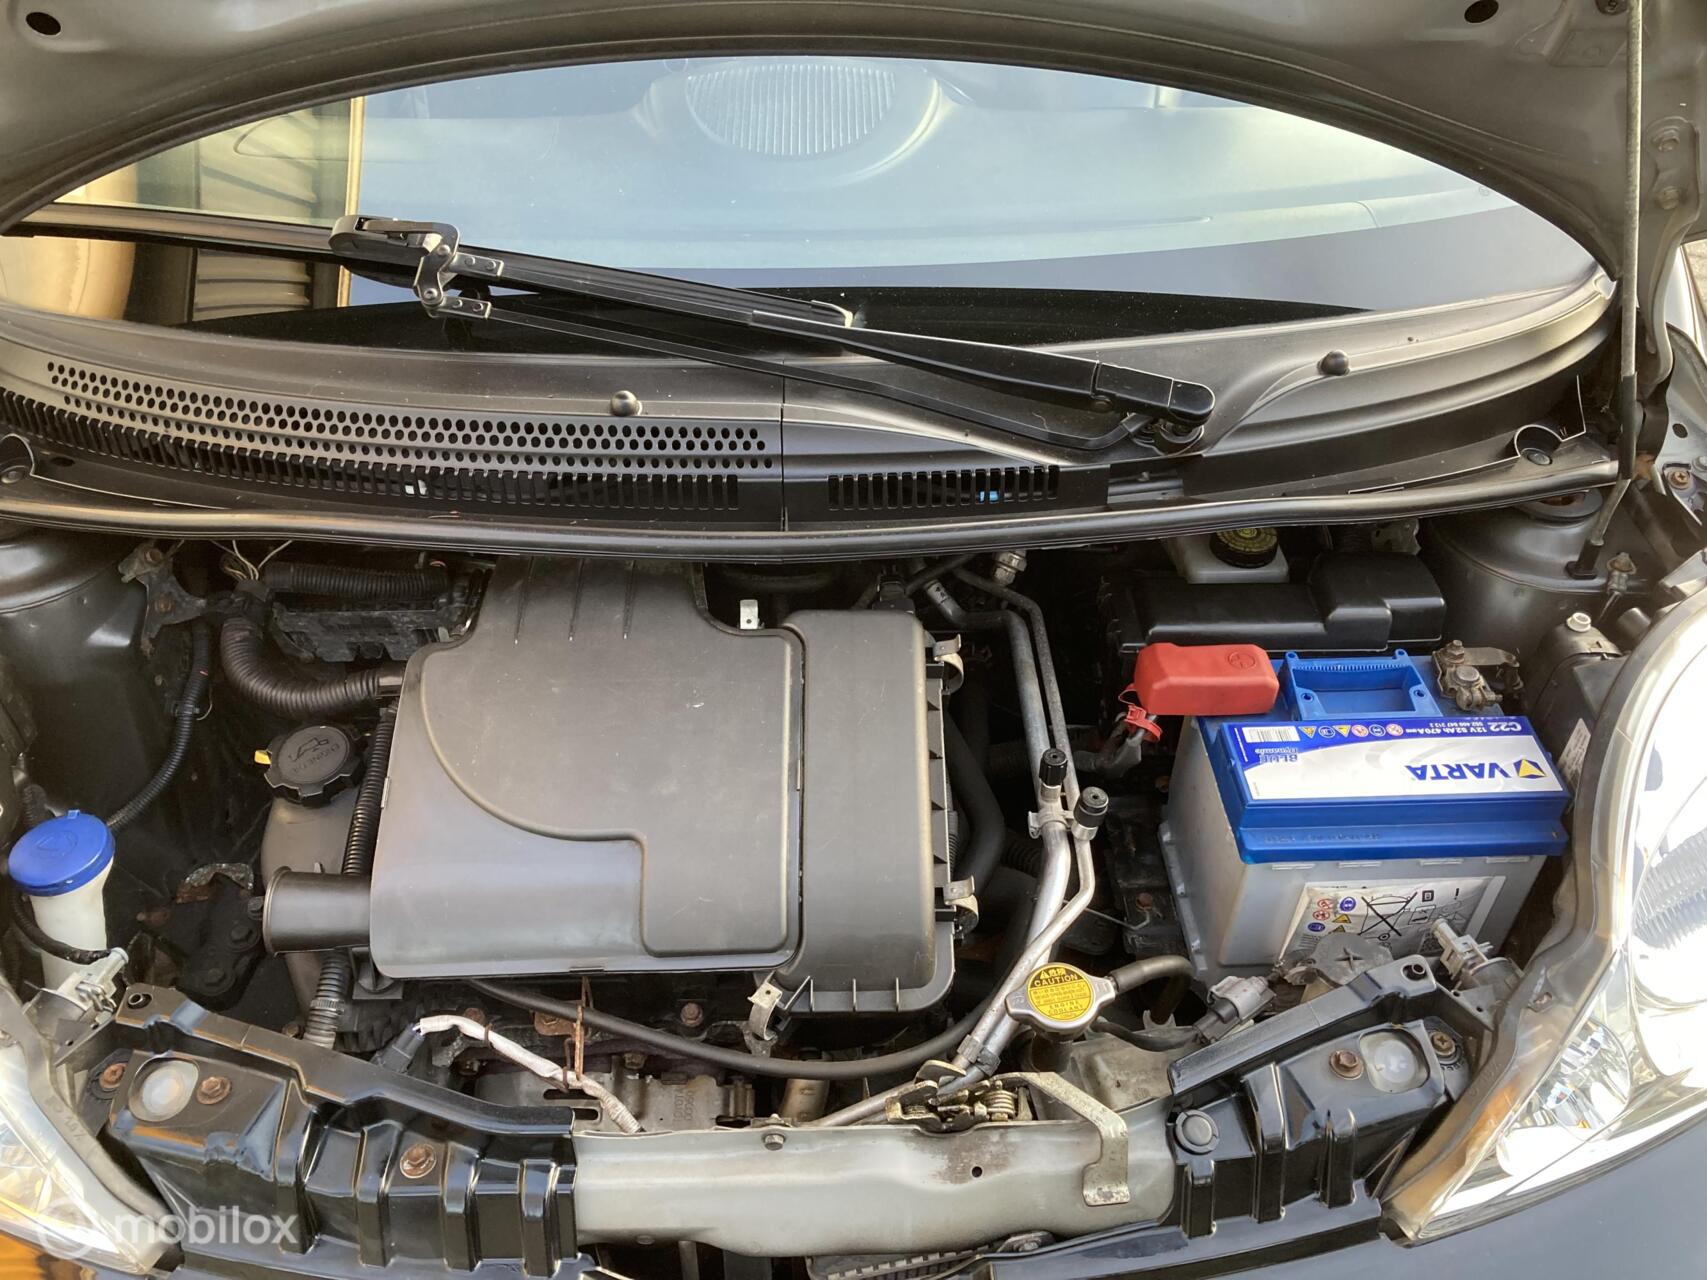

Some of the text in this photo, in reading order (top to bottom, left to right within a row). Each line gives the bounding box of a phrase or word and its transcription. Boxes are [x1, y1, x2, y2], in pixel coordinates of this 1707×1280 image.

[1486, 721, 1522, 732] C22
[1258, 754, 1298, 764] BLUE
[1405, 763, 1512, 781] VARTA
[1034, 974, 1078, 987] CAUTION
